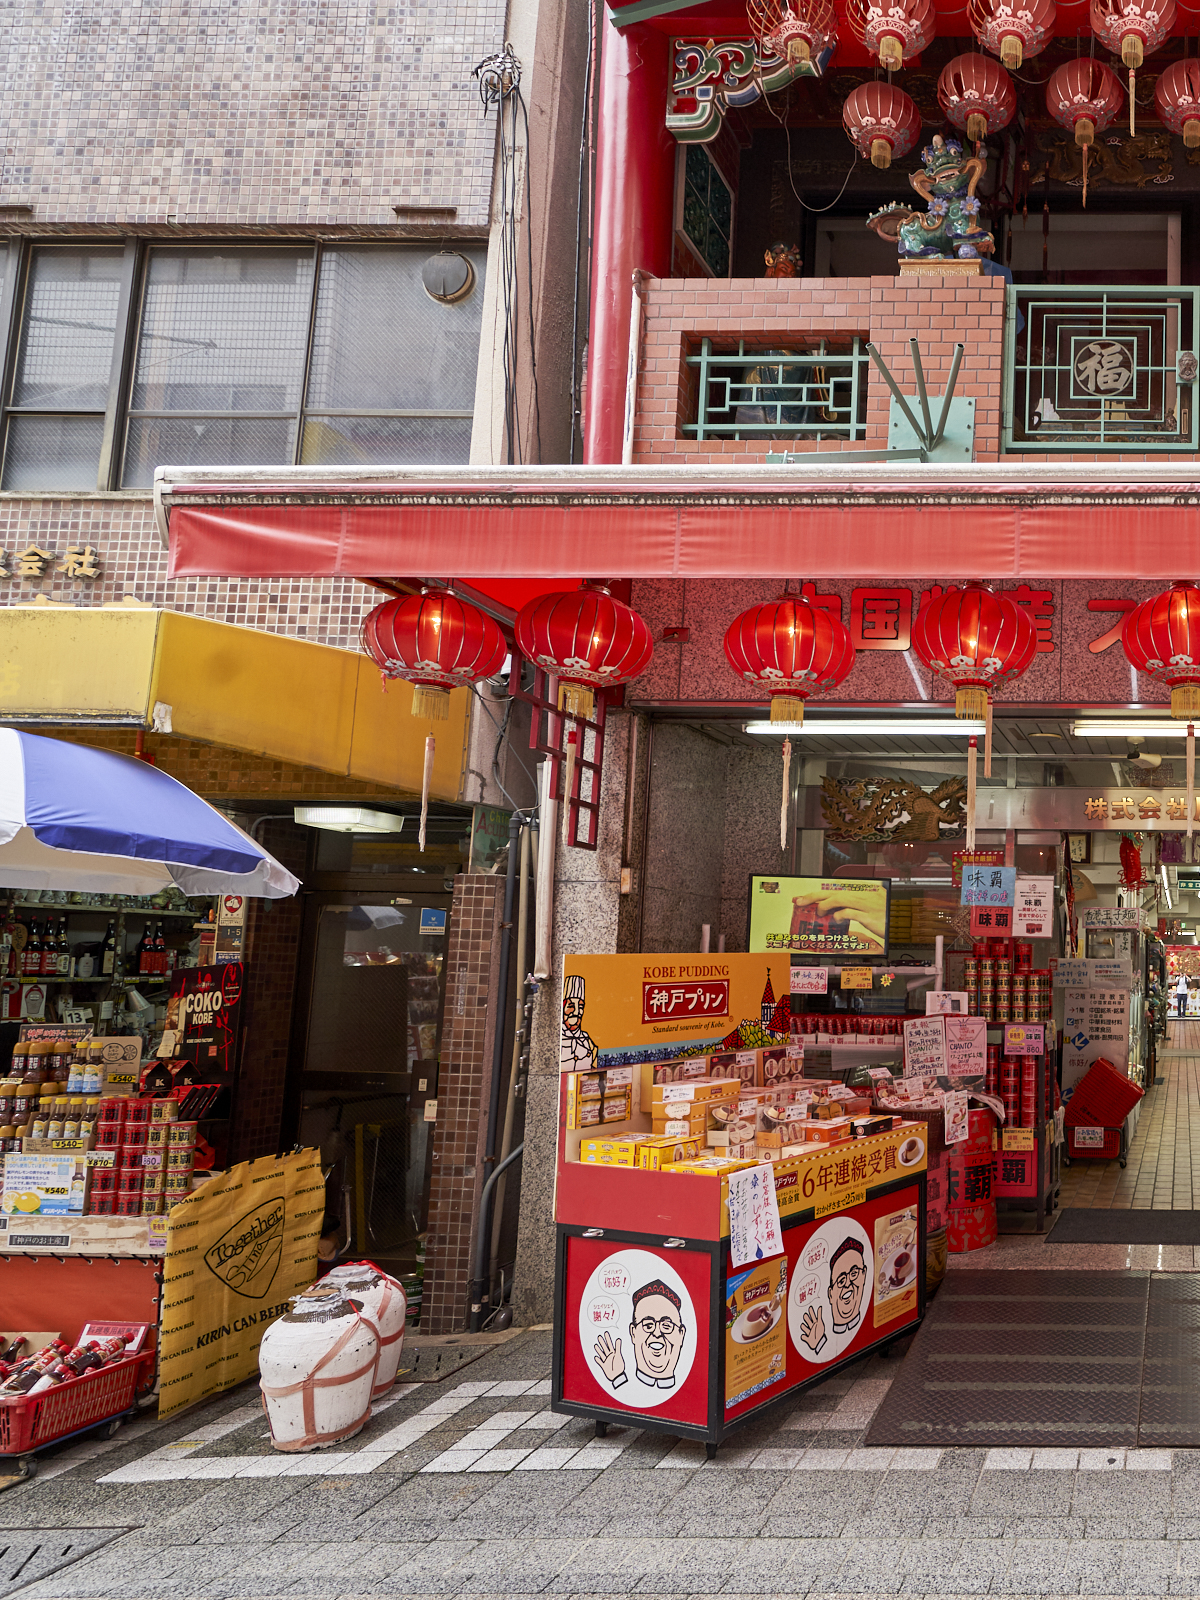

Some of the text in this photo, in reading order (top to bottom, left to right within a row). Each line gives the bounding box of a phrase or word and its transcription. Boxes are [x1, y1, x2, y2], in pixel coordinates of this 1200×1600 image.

[1078, 343, 1131, 394] 福
[0, 544, 101, 578] 会社
[978, 913, 1009, 927] 味覇
[643, 965, 730, 979] KOBE PUDDING
[186, 991, 222, 1013] COKO
[649, 987, 724, 1014] 神戸プリン
[67, 1013, 83, 1023] 13
[192, 1012, 213, 1025] KOBE
[652, 1025, 679, 1034] Standard
[679, 1023, 703, 1032] souvenir
[703, 1021, 711, 1030] of
[949, 1042, 973, 1050] CHANTO
[802, 1145, 898, 1198] 6年連続受賞
[252, 1176, 265, 1184] KIRIN
[816, 1191, 866, 1215] おかげさまで25周年
[175, 1222, 186, 1230] CAN
[211, 1206, 283, 1265] Together
[173, 1245, 198, 1256] CAN BEER
[171, 1274, 182, 1282] CAN
[604, 1277, 627, 1288] 你好!
[745, 1286, 769, 1301] 神戸プリン
[172, 1300, 183, 1308] CAN
[171, 1325, 183, 1333] CAN
[196, 1302, 290, 1349] KIRIN CAN BEER
[168, 1346, 194, 1360] CAN BEER
[168, 1378, 179, 1386] CAN
